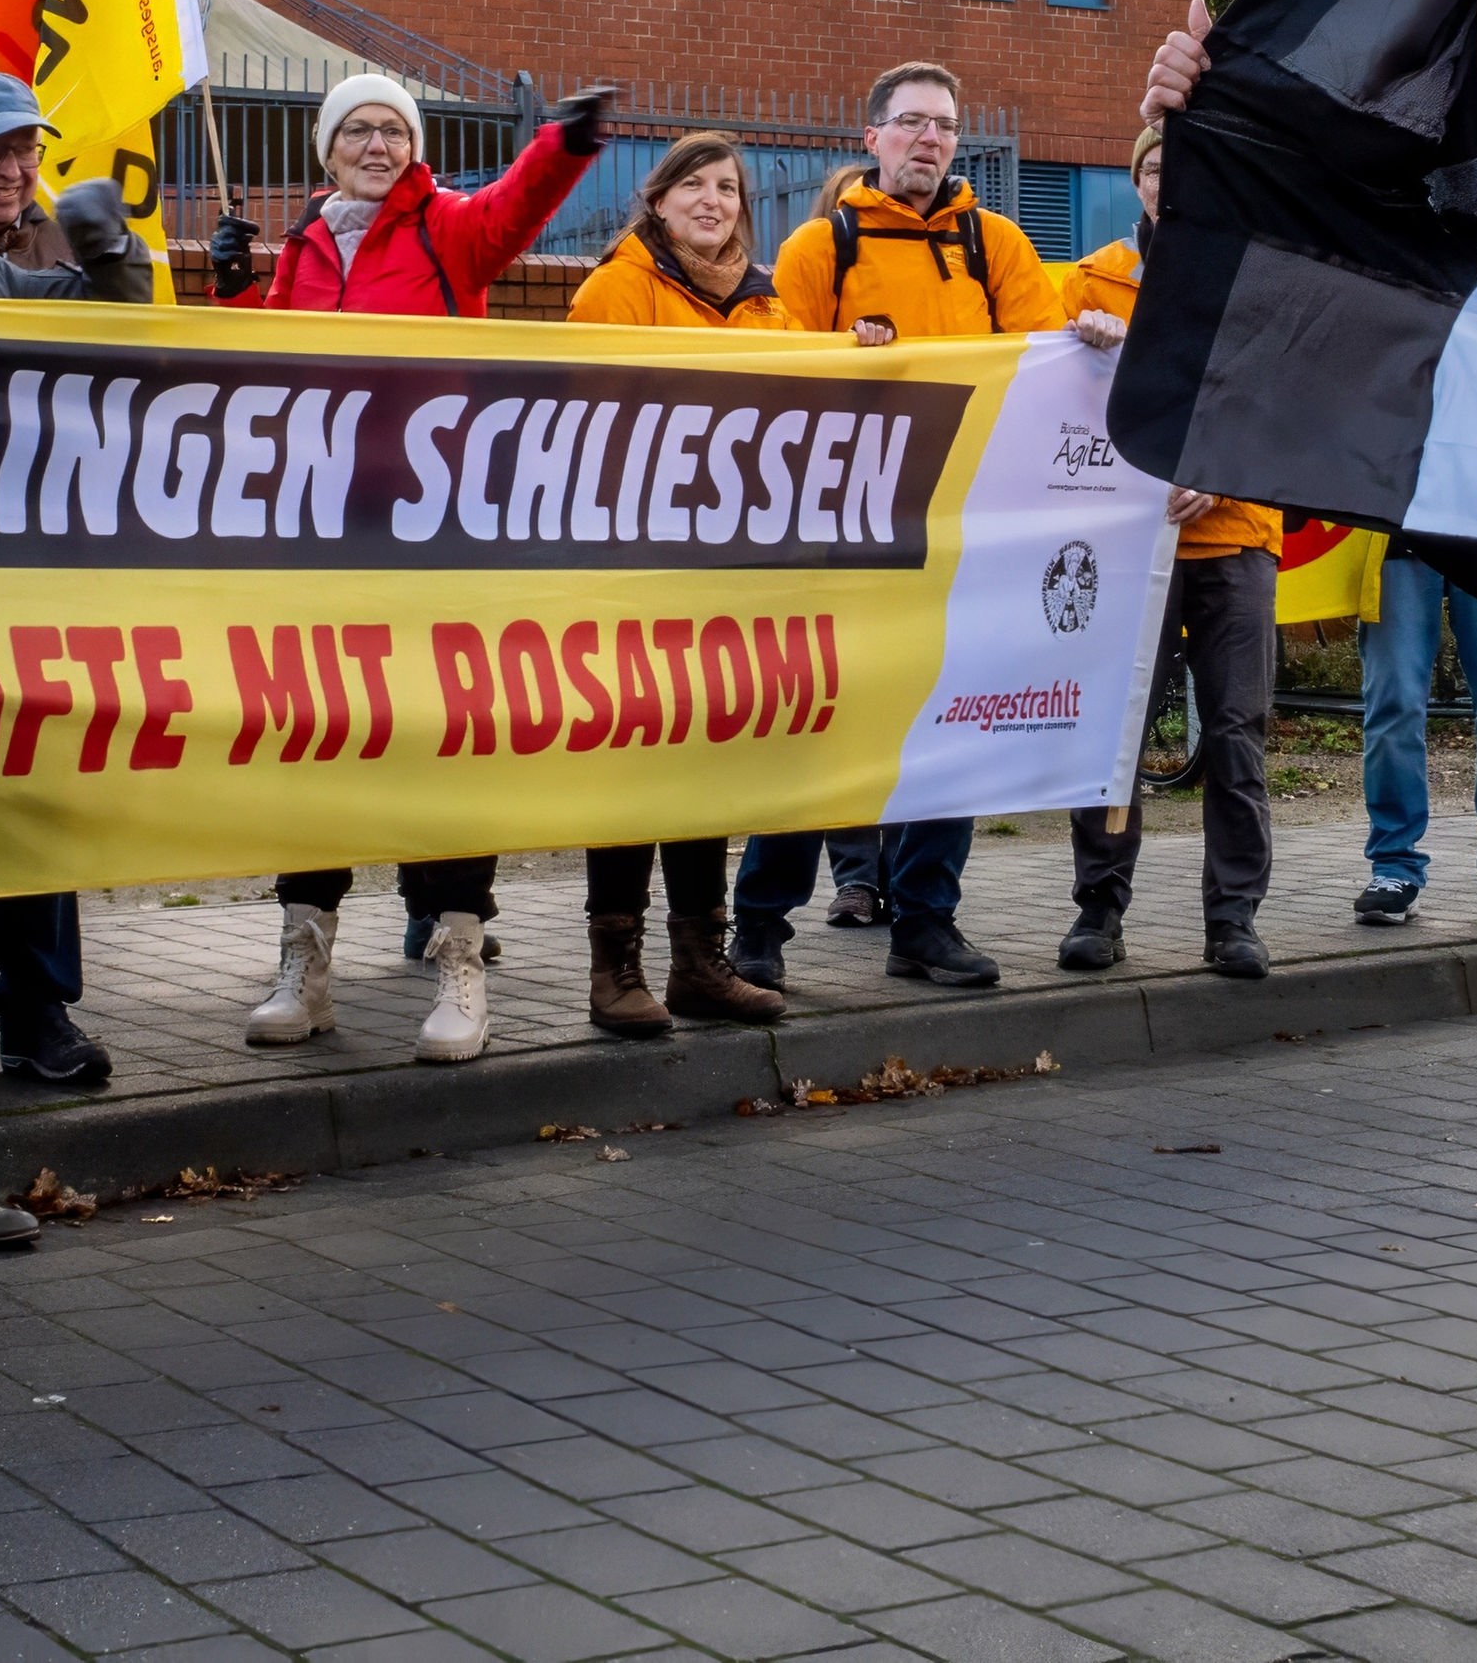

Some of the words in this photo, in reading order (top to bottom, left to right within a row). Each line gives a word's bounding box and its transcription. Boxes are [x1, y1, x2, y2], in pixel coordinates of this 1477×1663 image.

[391, 394, 911, 545] SCHLIESSEN
[228, 623, 393, 766] MIT
[432, 613, 842, 759] ROSATOM!
